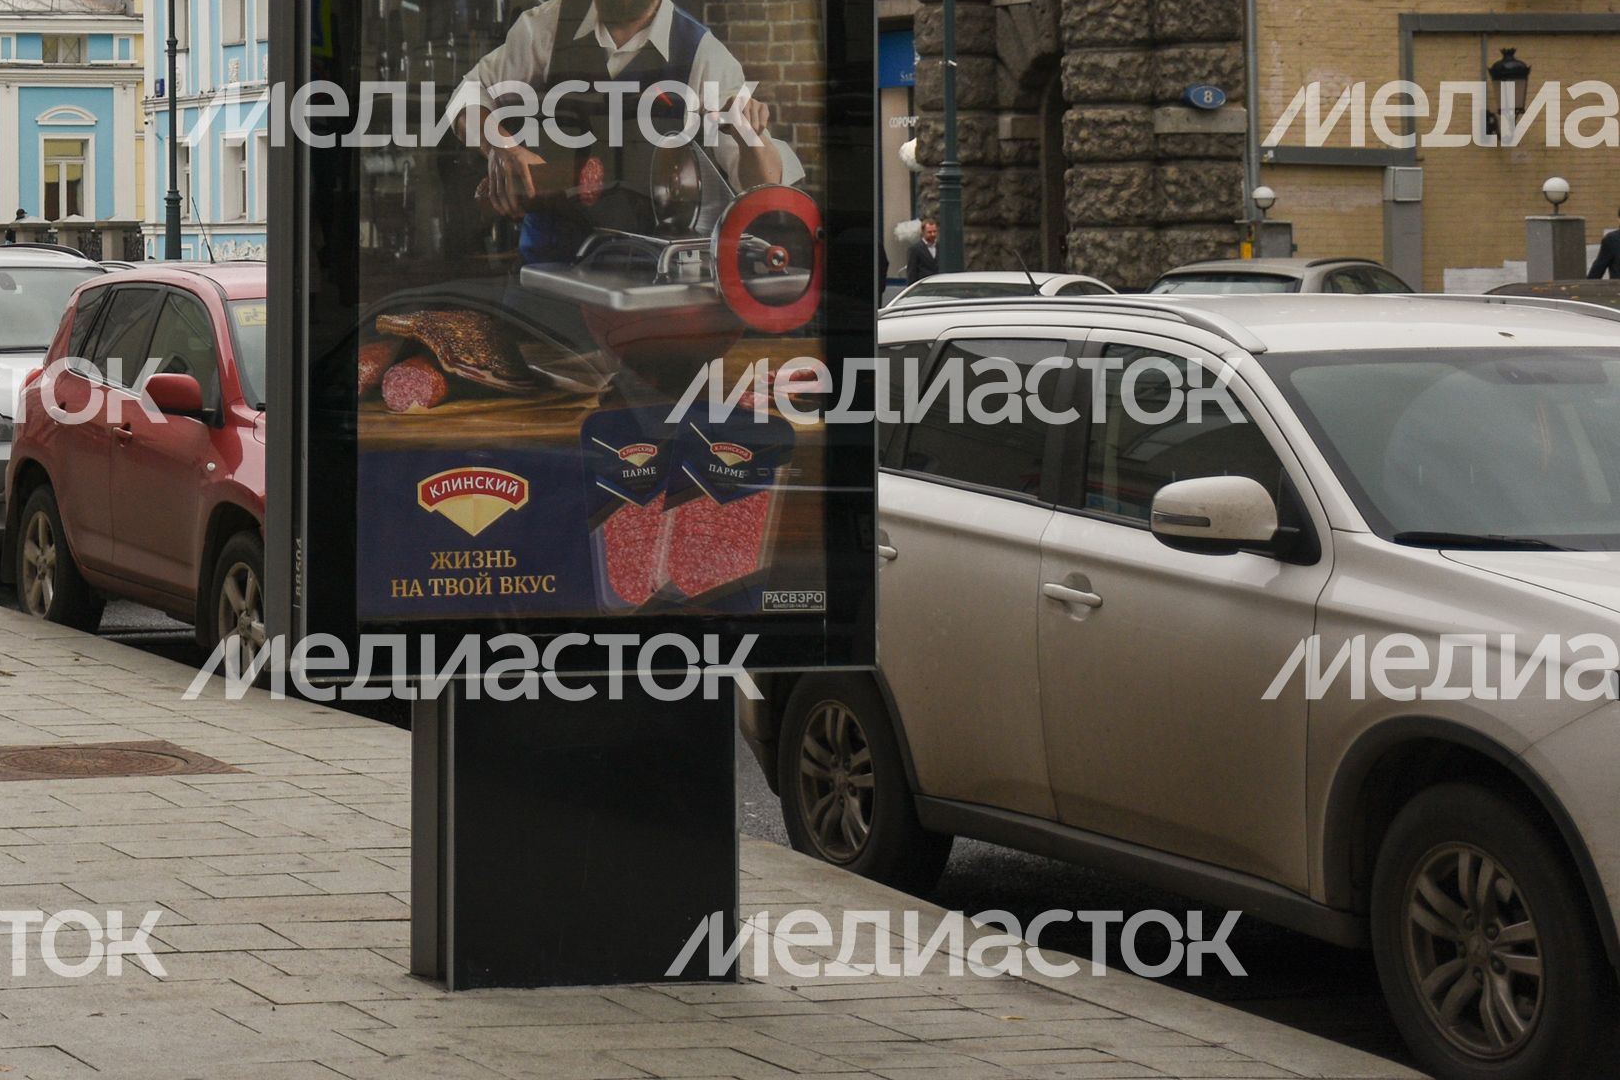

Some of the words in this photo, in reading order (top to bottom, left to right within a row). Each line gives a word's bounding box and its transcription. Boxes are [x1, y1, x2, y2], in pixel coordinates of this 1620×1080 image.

[1203, 90, 1213, 104] 8
[622, 466, 657, 479] ПАРМЕ
[429, 476, 519, 499] КЛИНСКИЙ
[430, 550, 517, 570] ЖИЗНЬ
[391, 579, 424, 598] НА
[428, 572, 492, 596] ТВОЙ
[499, 574, 556, 594] ВКУС
[765, 592, 823, 604] РАСВЭРО
